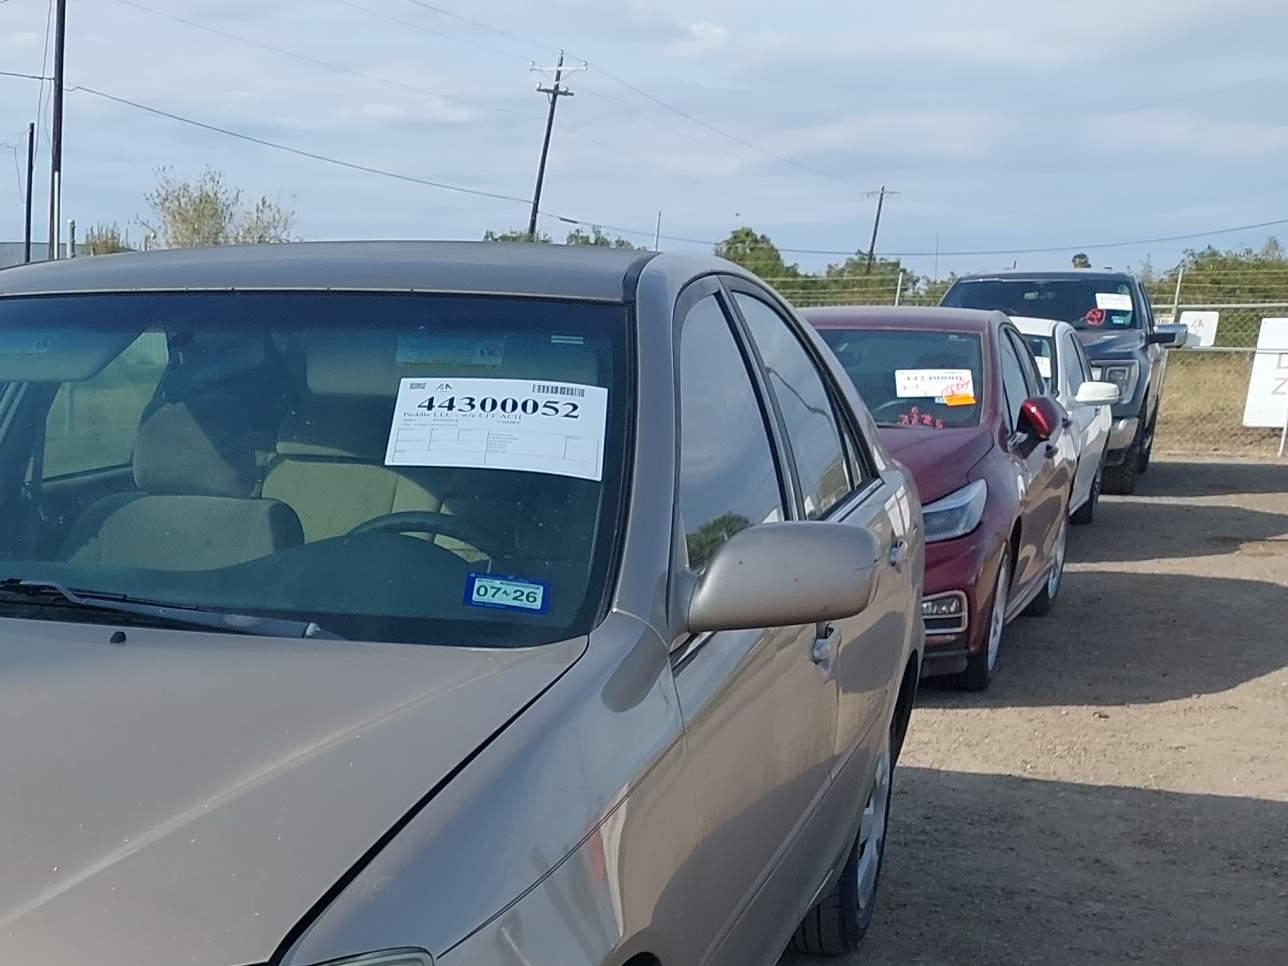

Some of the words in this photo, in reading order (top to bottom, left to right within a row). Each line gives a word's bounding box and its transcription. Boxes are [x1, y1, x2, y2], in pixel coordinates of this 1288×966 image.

[417, 396, 580, 419] 44300052
[476, 585, 502, 598] 07
[512, 589, 537, 603] 26
